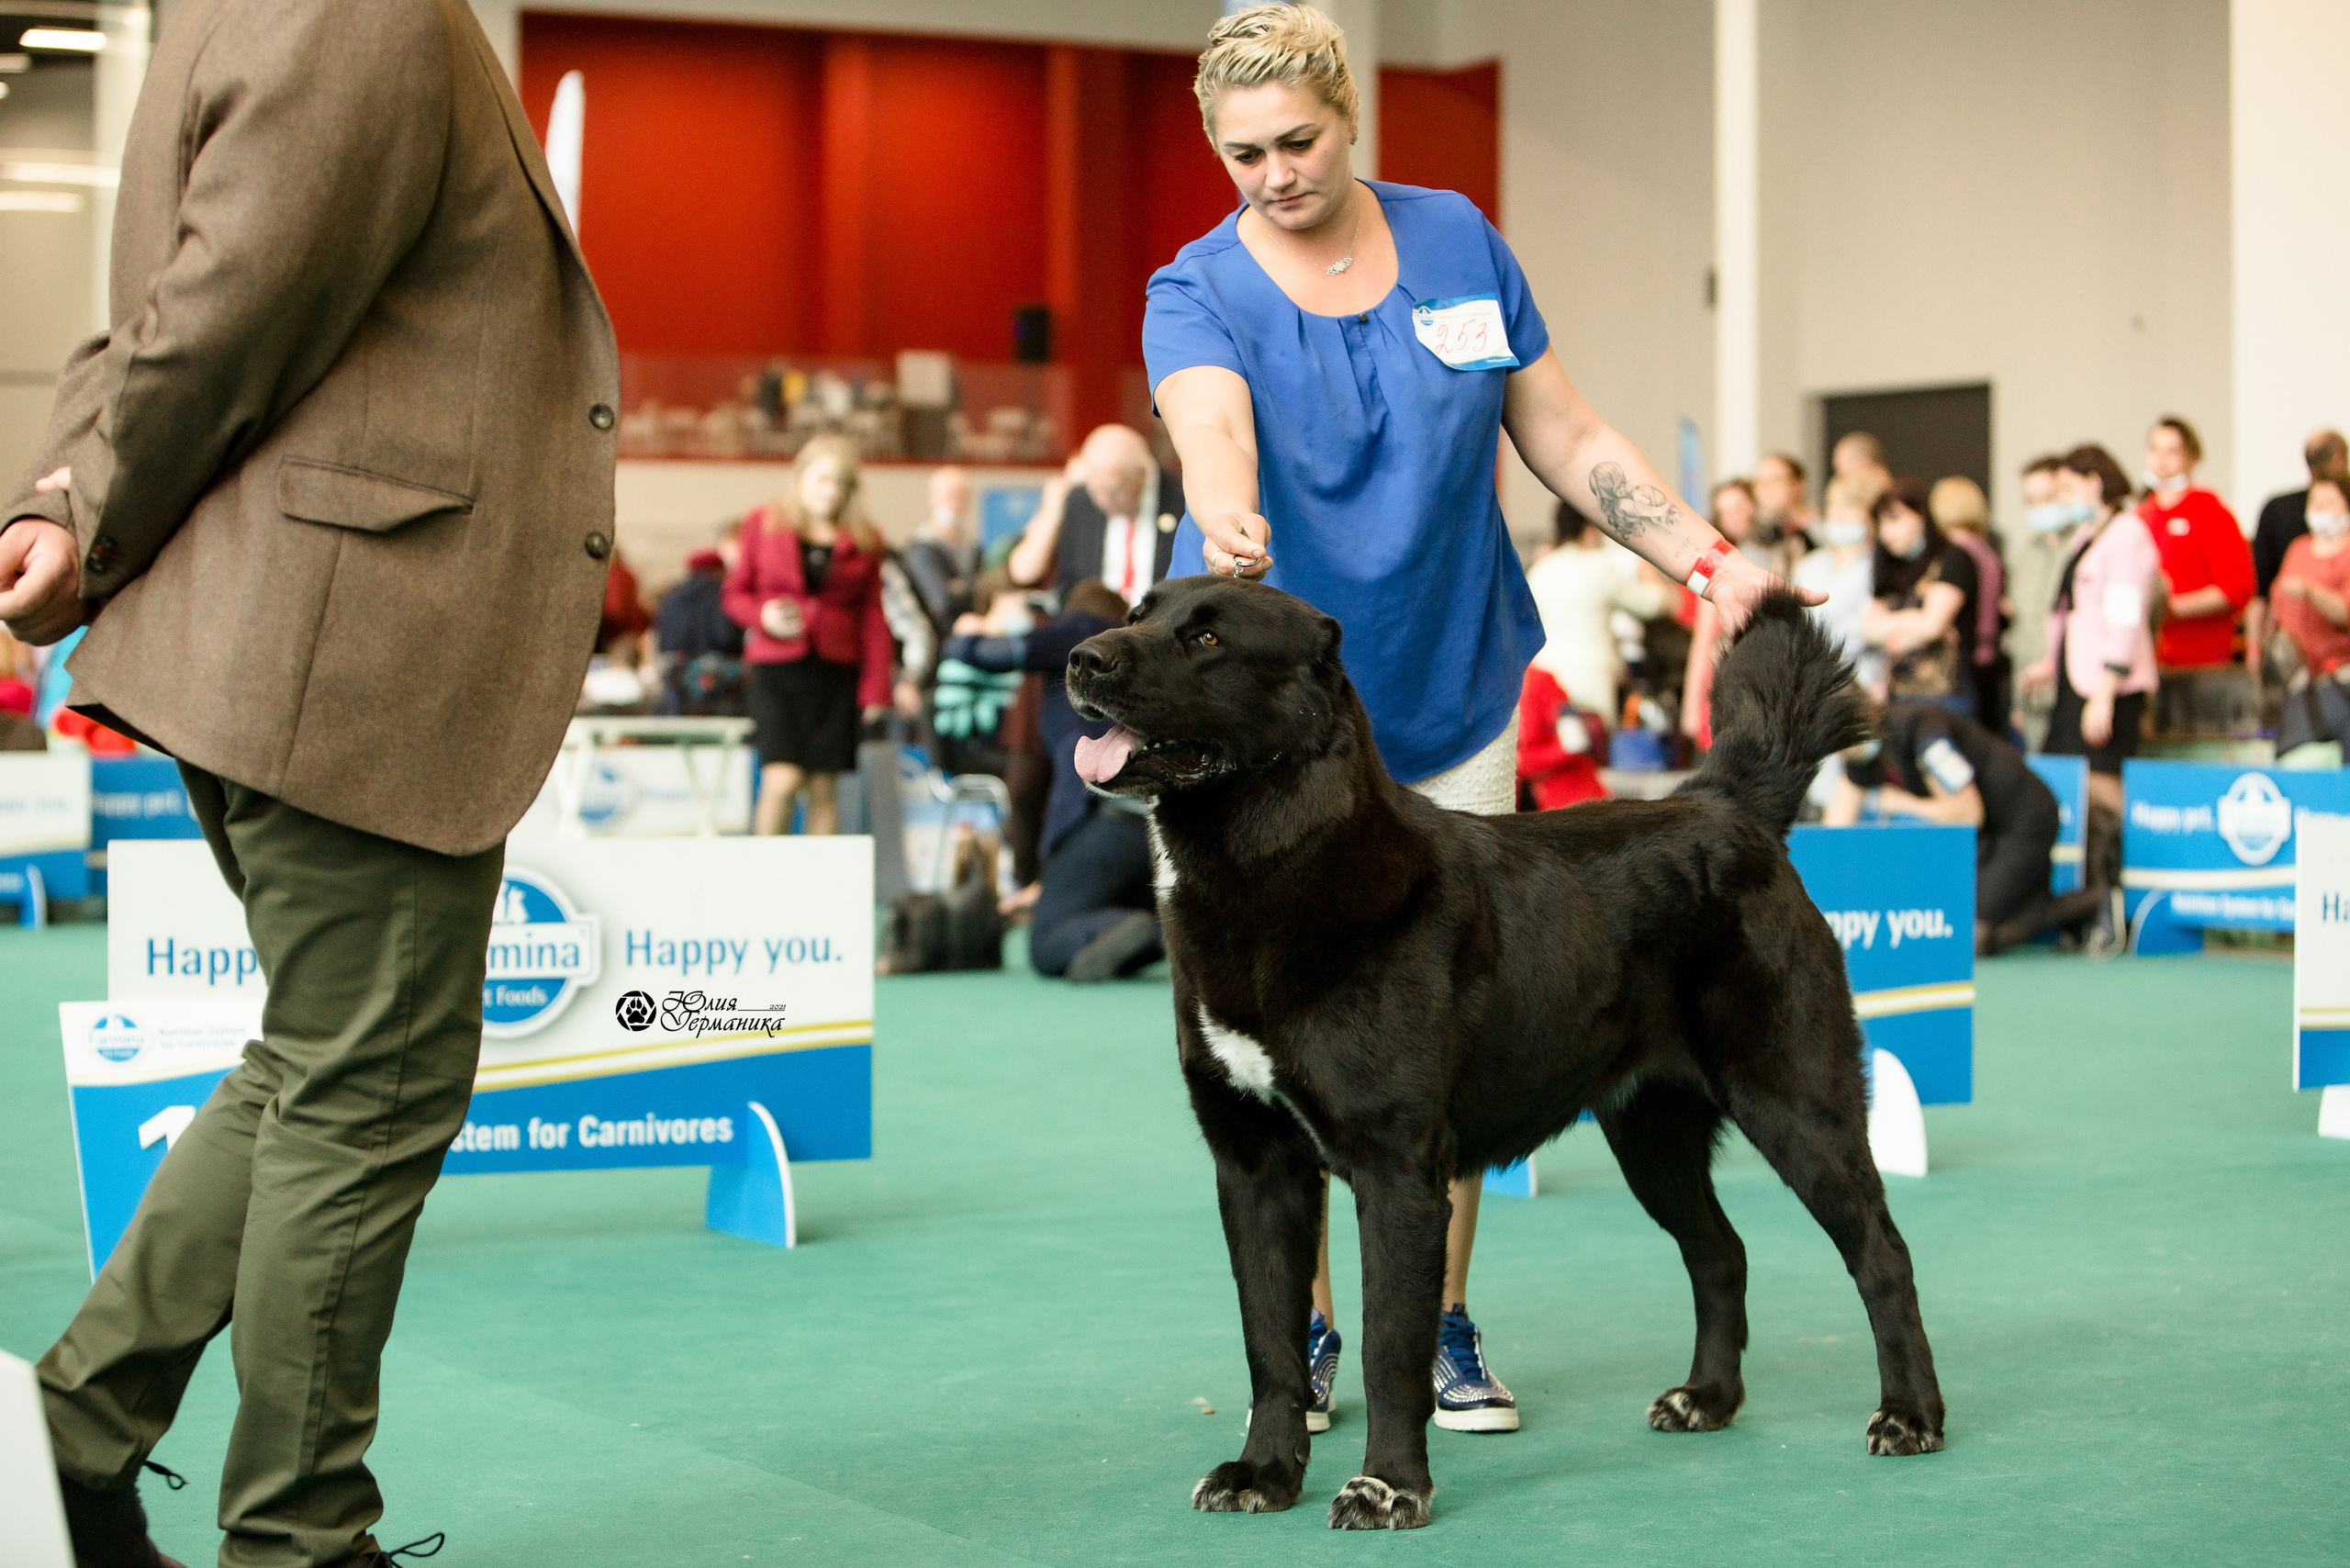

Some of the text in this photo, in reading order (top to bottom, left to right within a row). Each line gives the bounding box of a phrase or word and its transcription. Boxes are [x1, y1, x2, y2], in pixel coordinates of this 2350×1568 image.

[1435, 319, 1488, 353] 253
[1822, 908, 1953, 950] ppy you.
[147, 937, 258, 986] Happ
[489, 932, 580, 969] mina
[626, 930, 843, 976] Happy you.
[450, 1112, 733, 1153] stem for Carnivores
